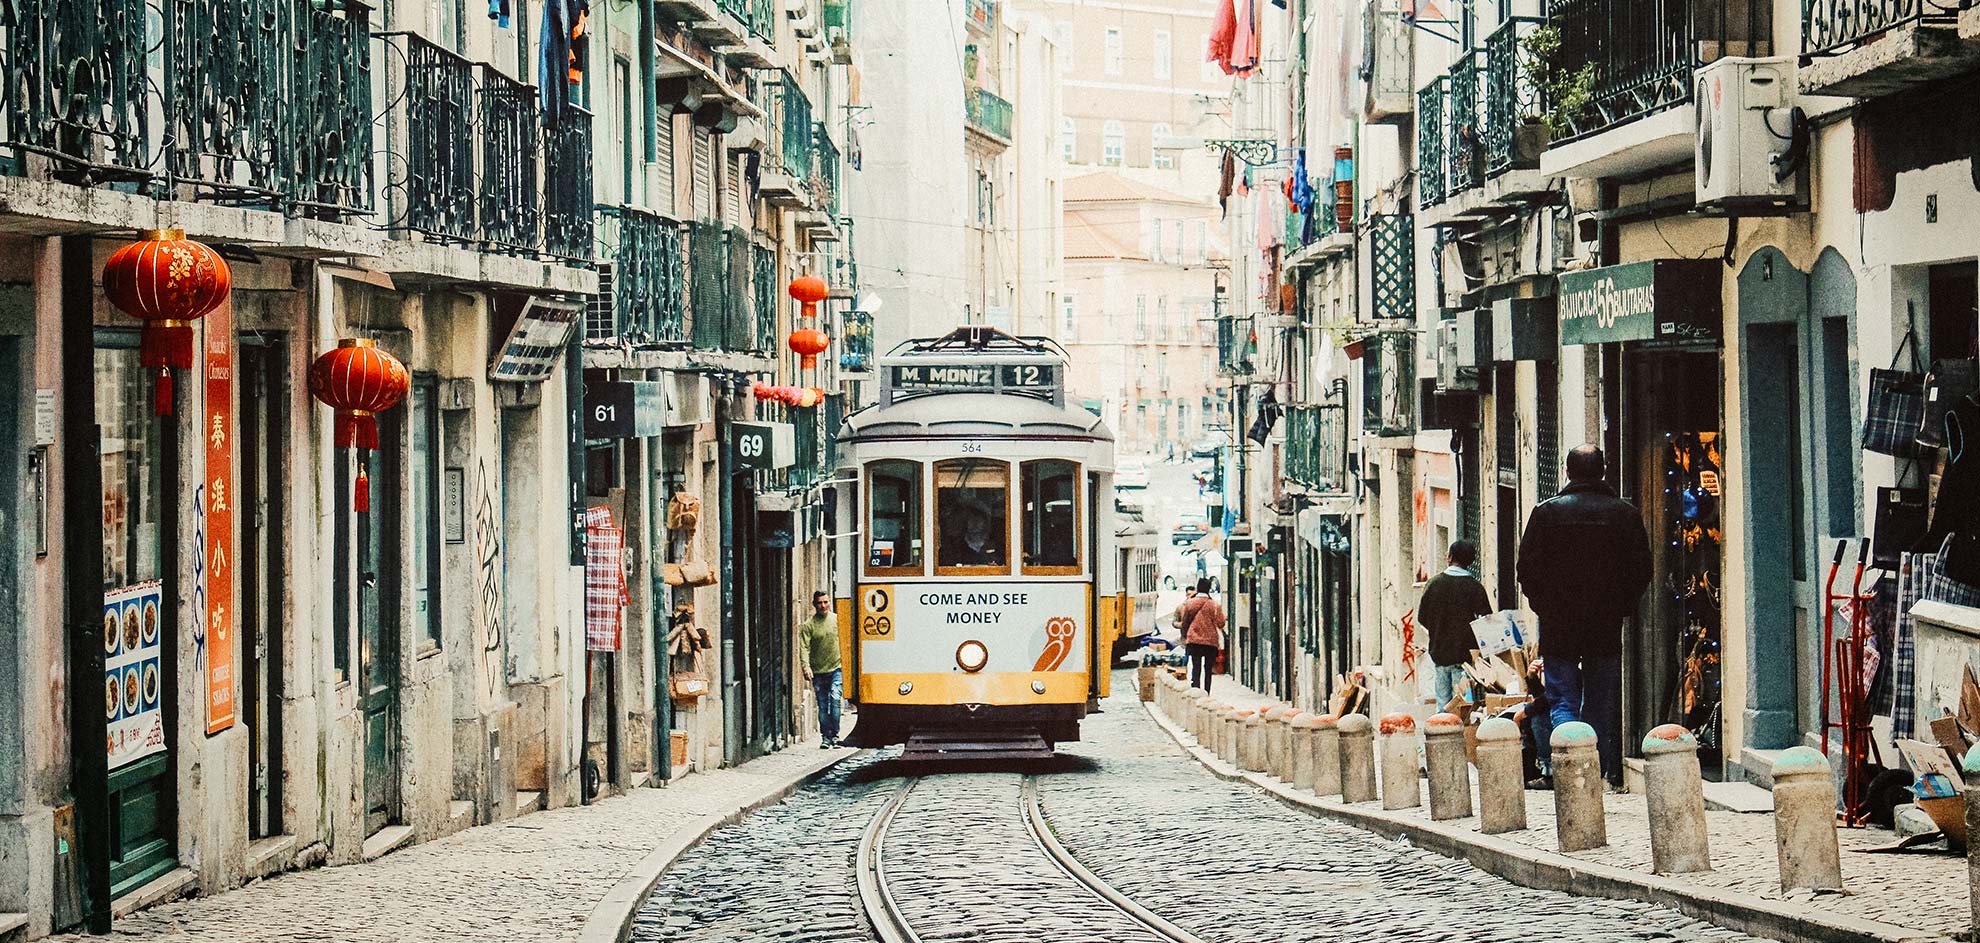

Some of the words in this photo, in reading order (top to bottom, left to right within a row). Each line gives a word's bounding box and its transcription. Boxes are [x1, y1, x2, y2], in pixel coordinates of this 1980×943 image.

[1598, 276, 1614, 328] 56
[1613, 284, 1654, 318] BIJUTARIAS
[901, 367, 920, 381] M.
[930, 368, 993, 383] MONIZ
[1013, 366, 1039, 385] 12
[595, 404, 615, 422] 61
[740, 434, 763, 457] 69
[962, 443, 982, 453] 564
[211, 411, 226, 640] 秦淮小吃
[920, 593, 963, 605] COME
[966, 593, 999, 605] AND
[1003, 593, 1028, 605] SEE
[946, 612, 1002, 624] MONEY
